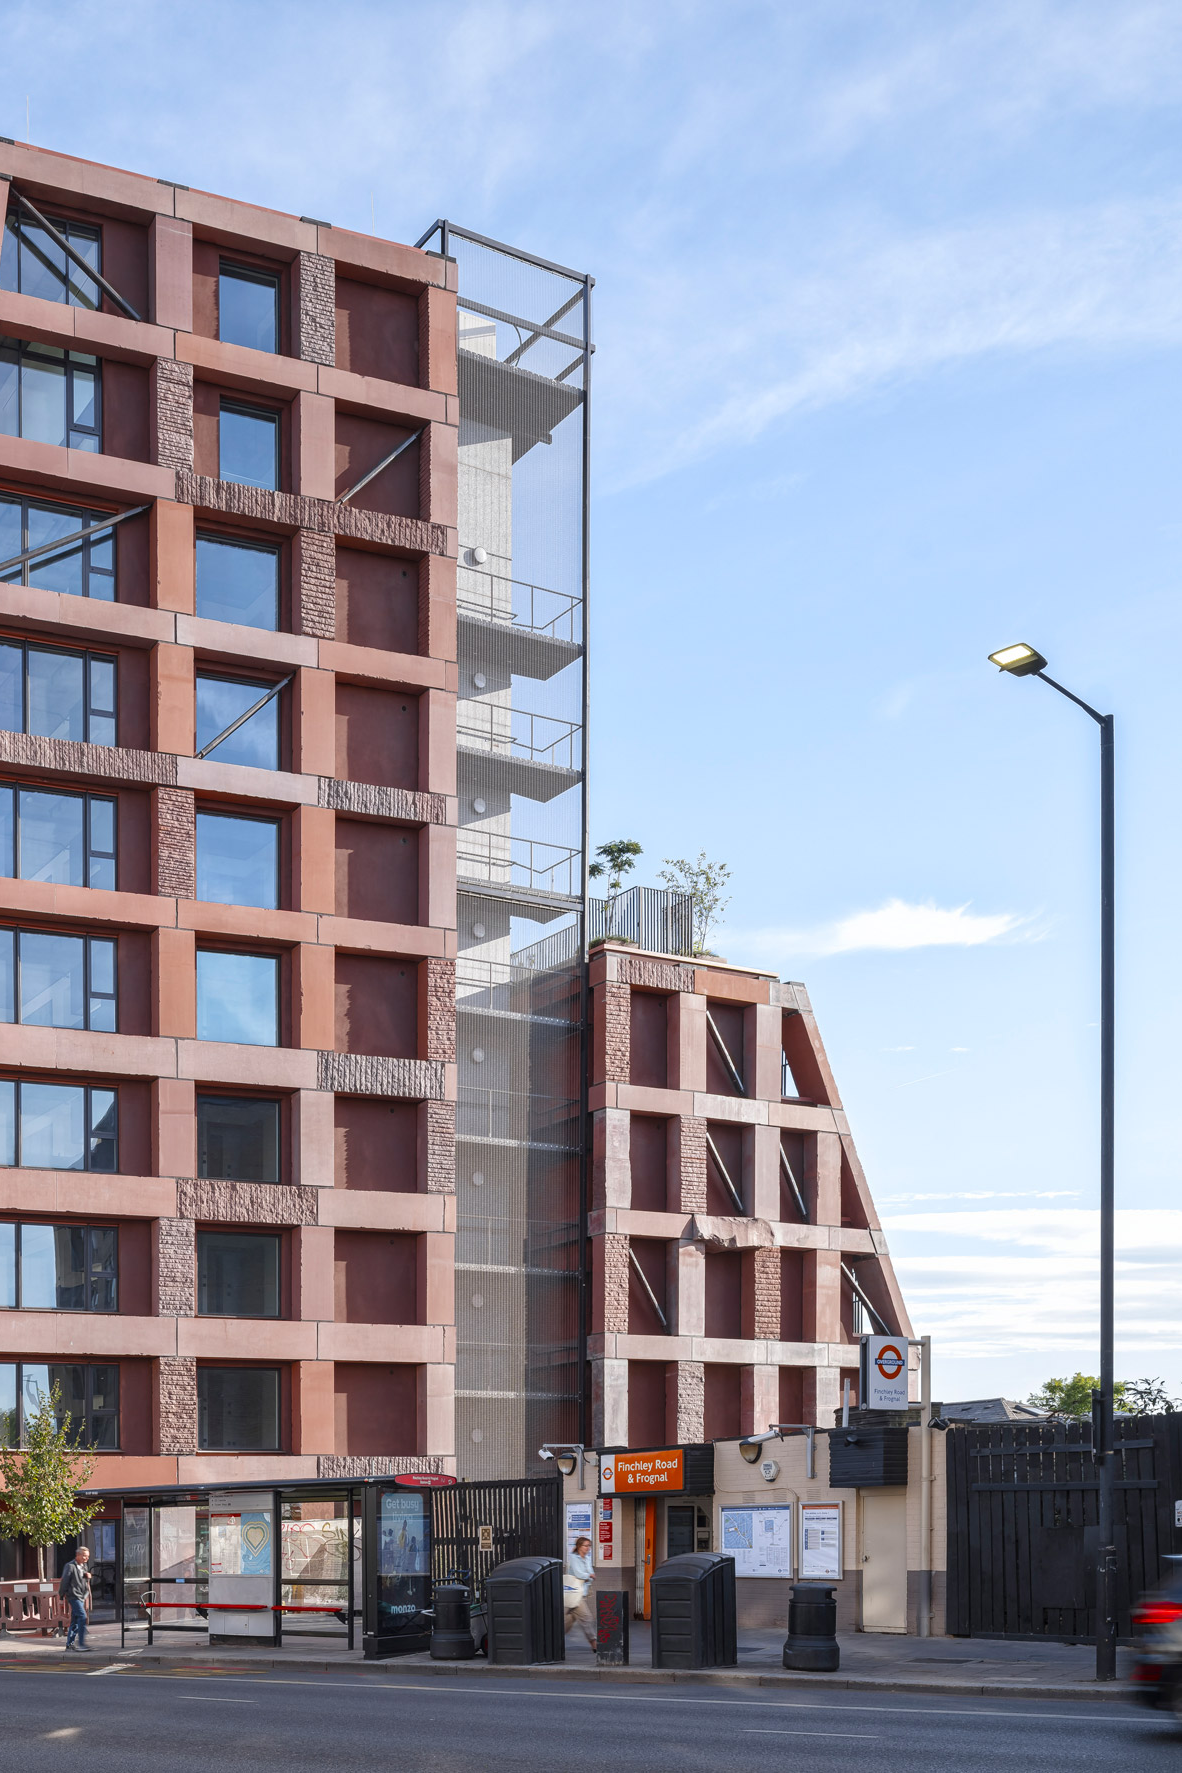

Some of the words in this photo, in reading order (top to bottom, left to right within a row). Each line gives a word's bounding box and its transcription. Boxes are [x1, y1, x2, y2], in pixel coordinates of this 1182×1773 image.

[874, 1388, 893, 1396] Finchley
[617, 1461, 653, 1472] Finchley
[655, 1458, 678, 1470] Road
[627, 1473, 634, 1484] &
[636, 1472, 668, 1484] Frognal
[386, 1498, 400, 1509] Get
[401, 1498, 419, 1511] busy
[390, 1603, 416, 1614] monzo
